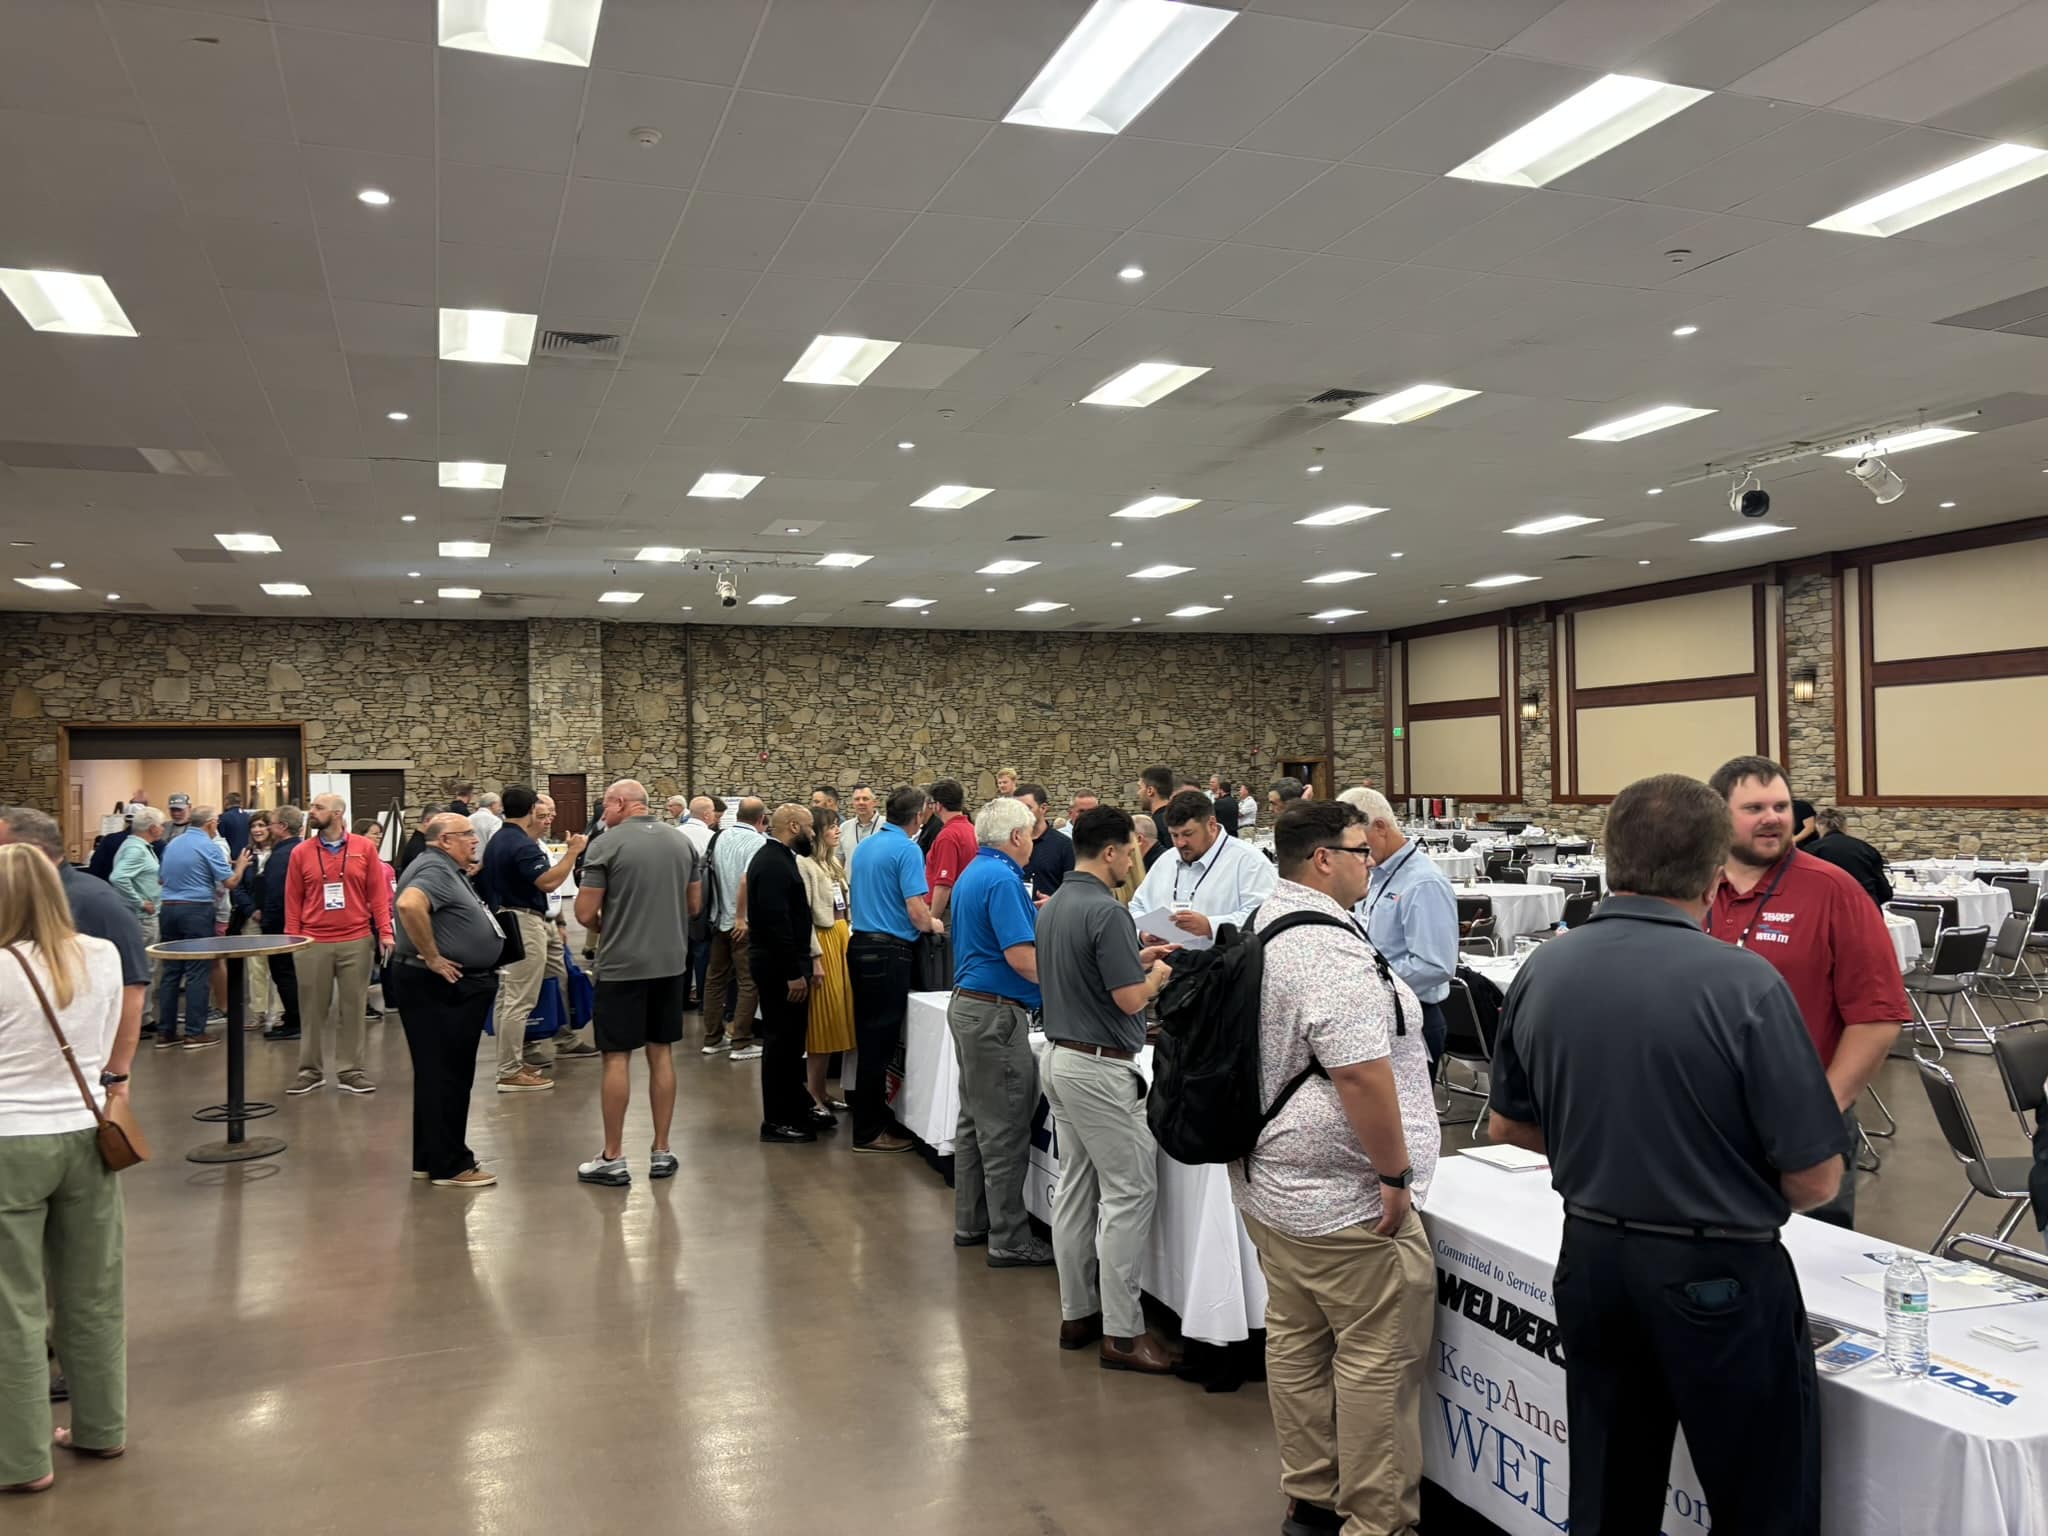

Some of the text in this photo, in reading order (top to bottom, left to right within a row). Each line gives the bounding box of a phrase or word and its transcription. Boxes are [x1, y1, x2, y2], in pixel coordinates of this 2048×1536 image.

[1437, 1239, 1547, 1302] Committed to Service
